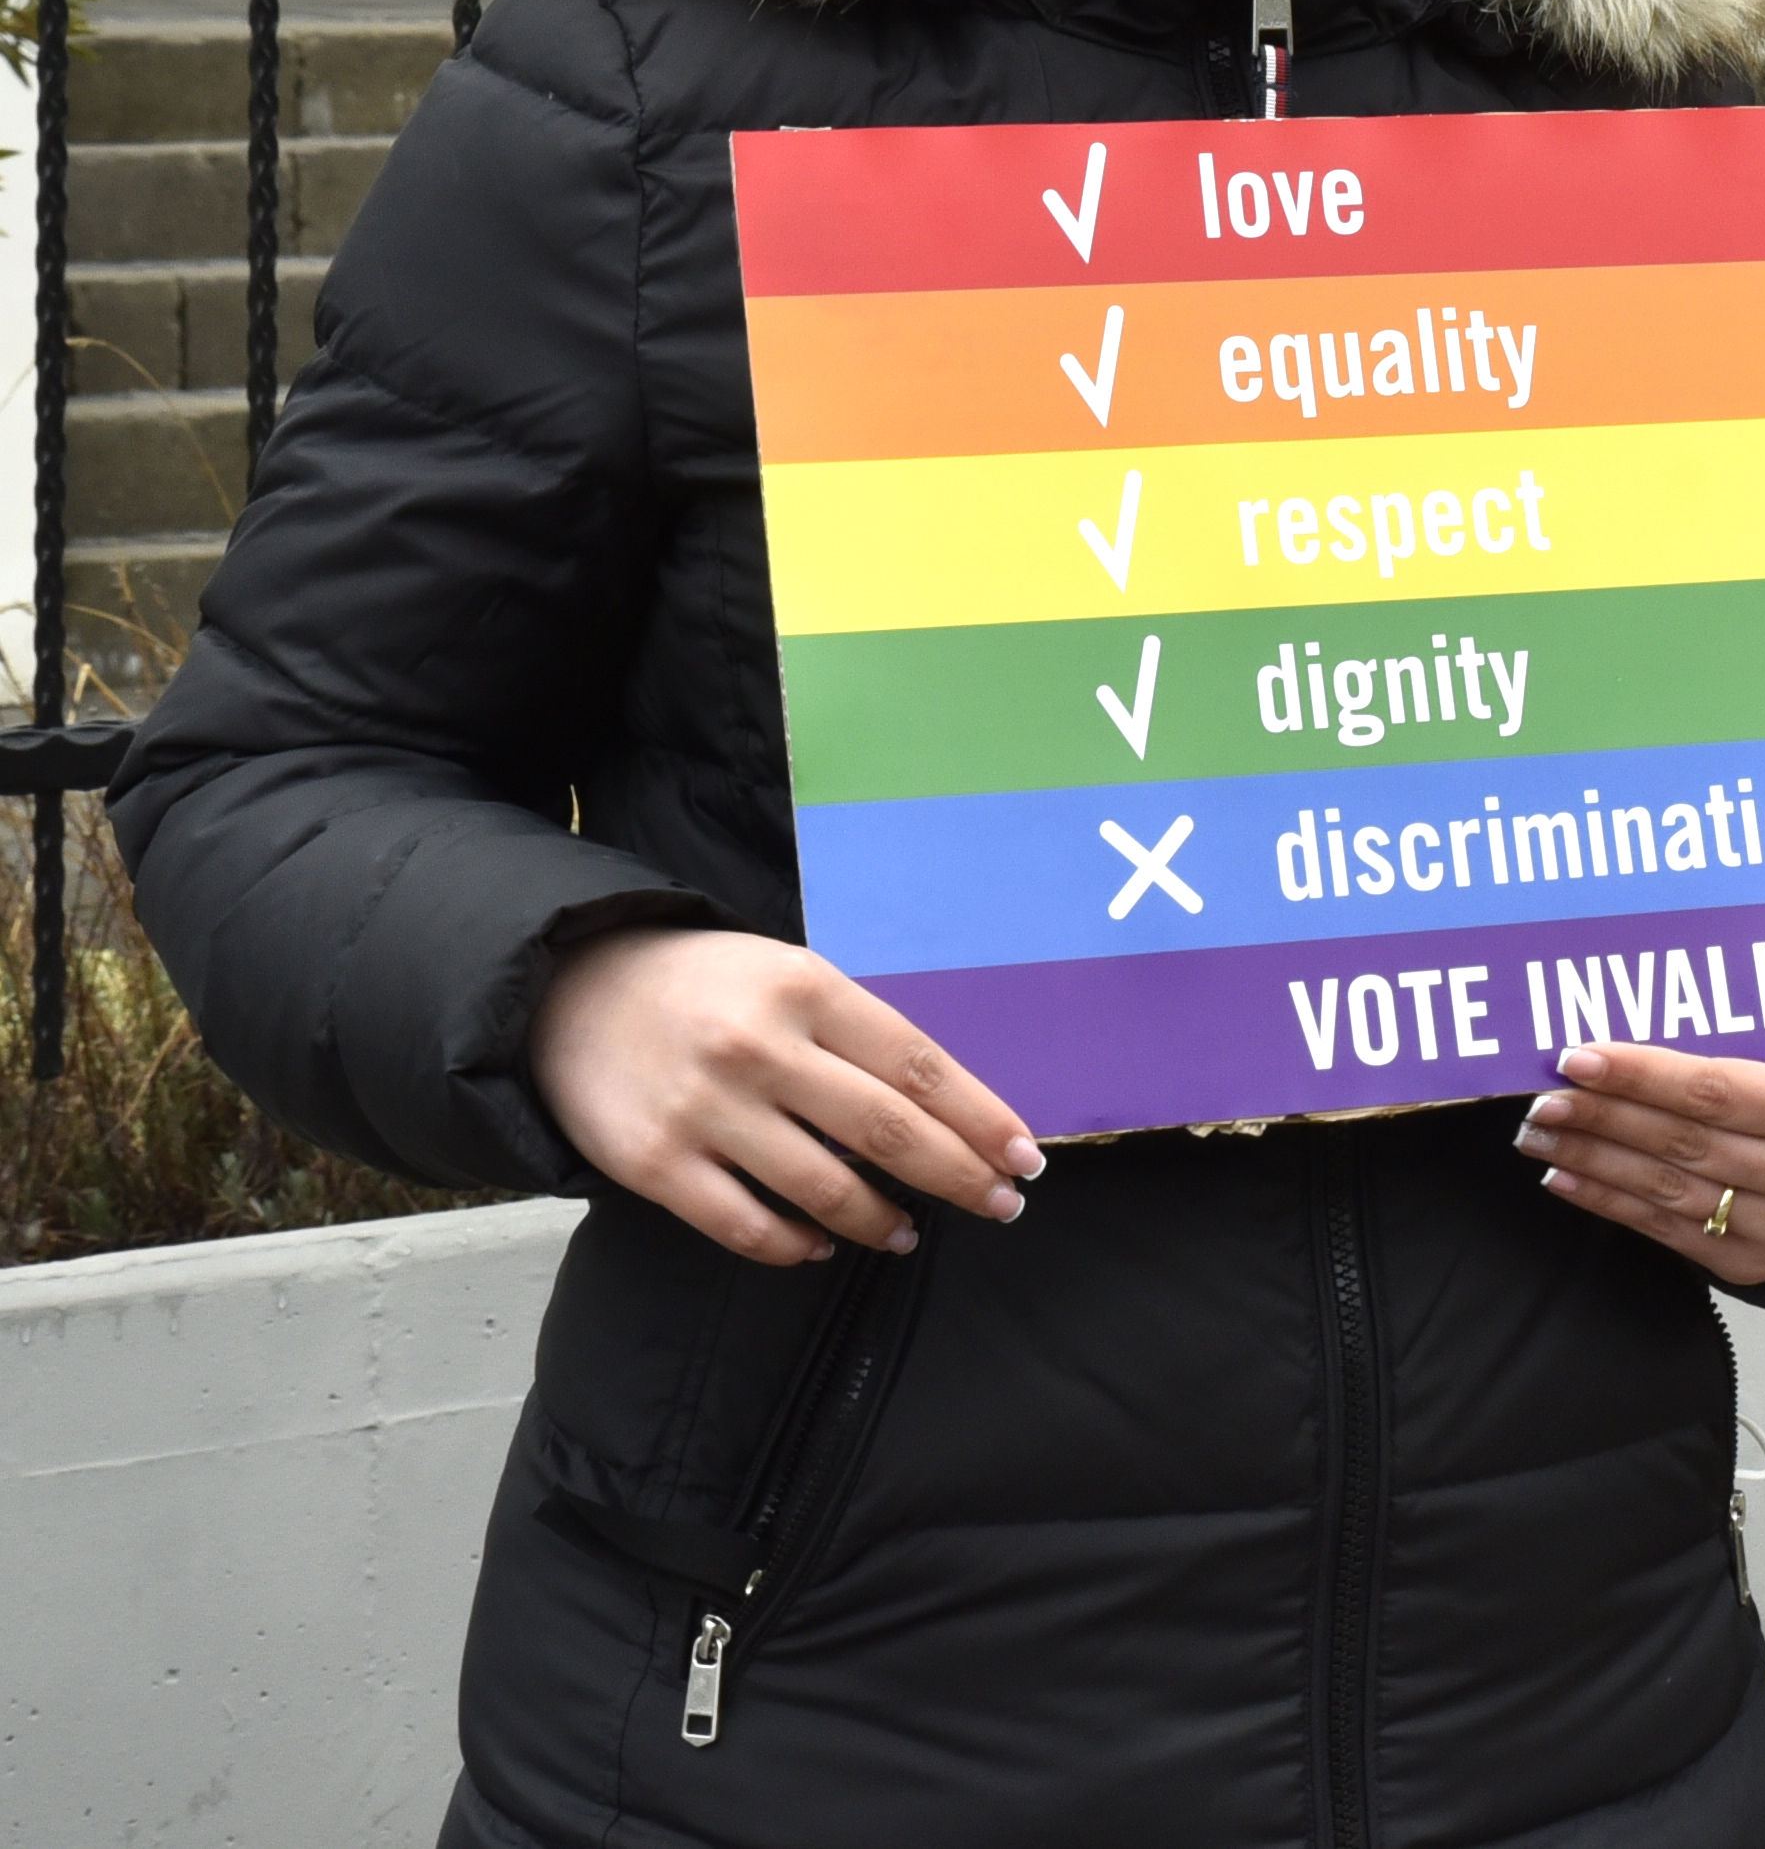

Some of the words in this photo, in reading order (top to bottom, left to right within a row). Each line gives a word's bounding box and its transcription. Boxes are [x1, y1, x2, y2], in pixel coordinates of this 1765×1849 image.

[1199, 153, 1364, 238] love
[1220, 307, 1536, 418] equality
[1239, 470, 1551, 578] respect
[1257, 634, 1528, 746] dignity
[1289, 966, 1499, 1070] VOTE
